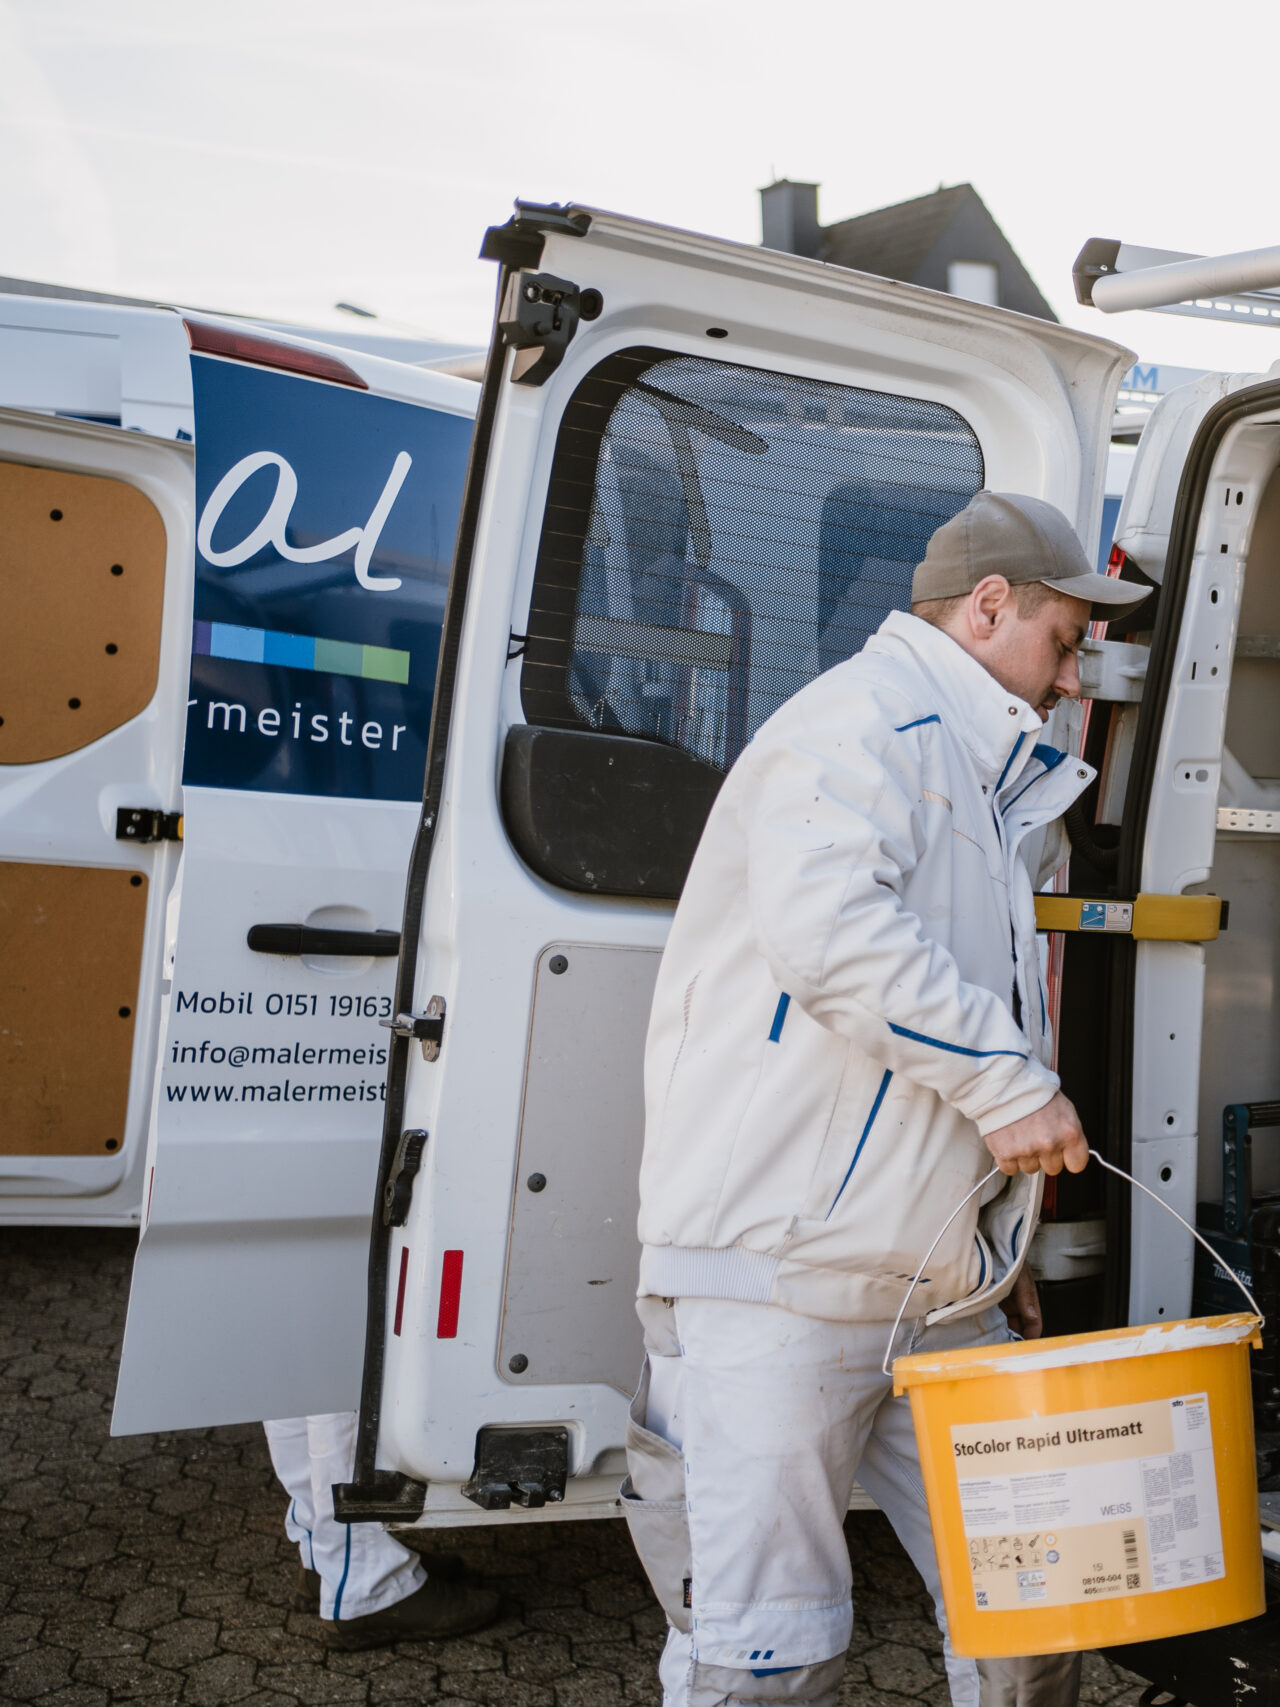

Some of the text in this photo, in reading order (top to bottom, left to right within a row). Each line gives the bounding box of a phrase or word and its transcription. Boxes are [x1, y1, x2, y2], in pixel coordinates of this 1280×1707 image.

[175, 991, 392, 1018] Mobil 0151 19163
[171, 1040, 387, 1068] info@malermeis
[954, 1421, 1143, 1457] StoColor Rapid Ultramatt
[1100, 1502, 1132, 1516] WEISS
